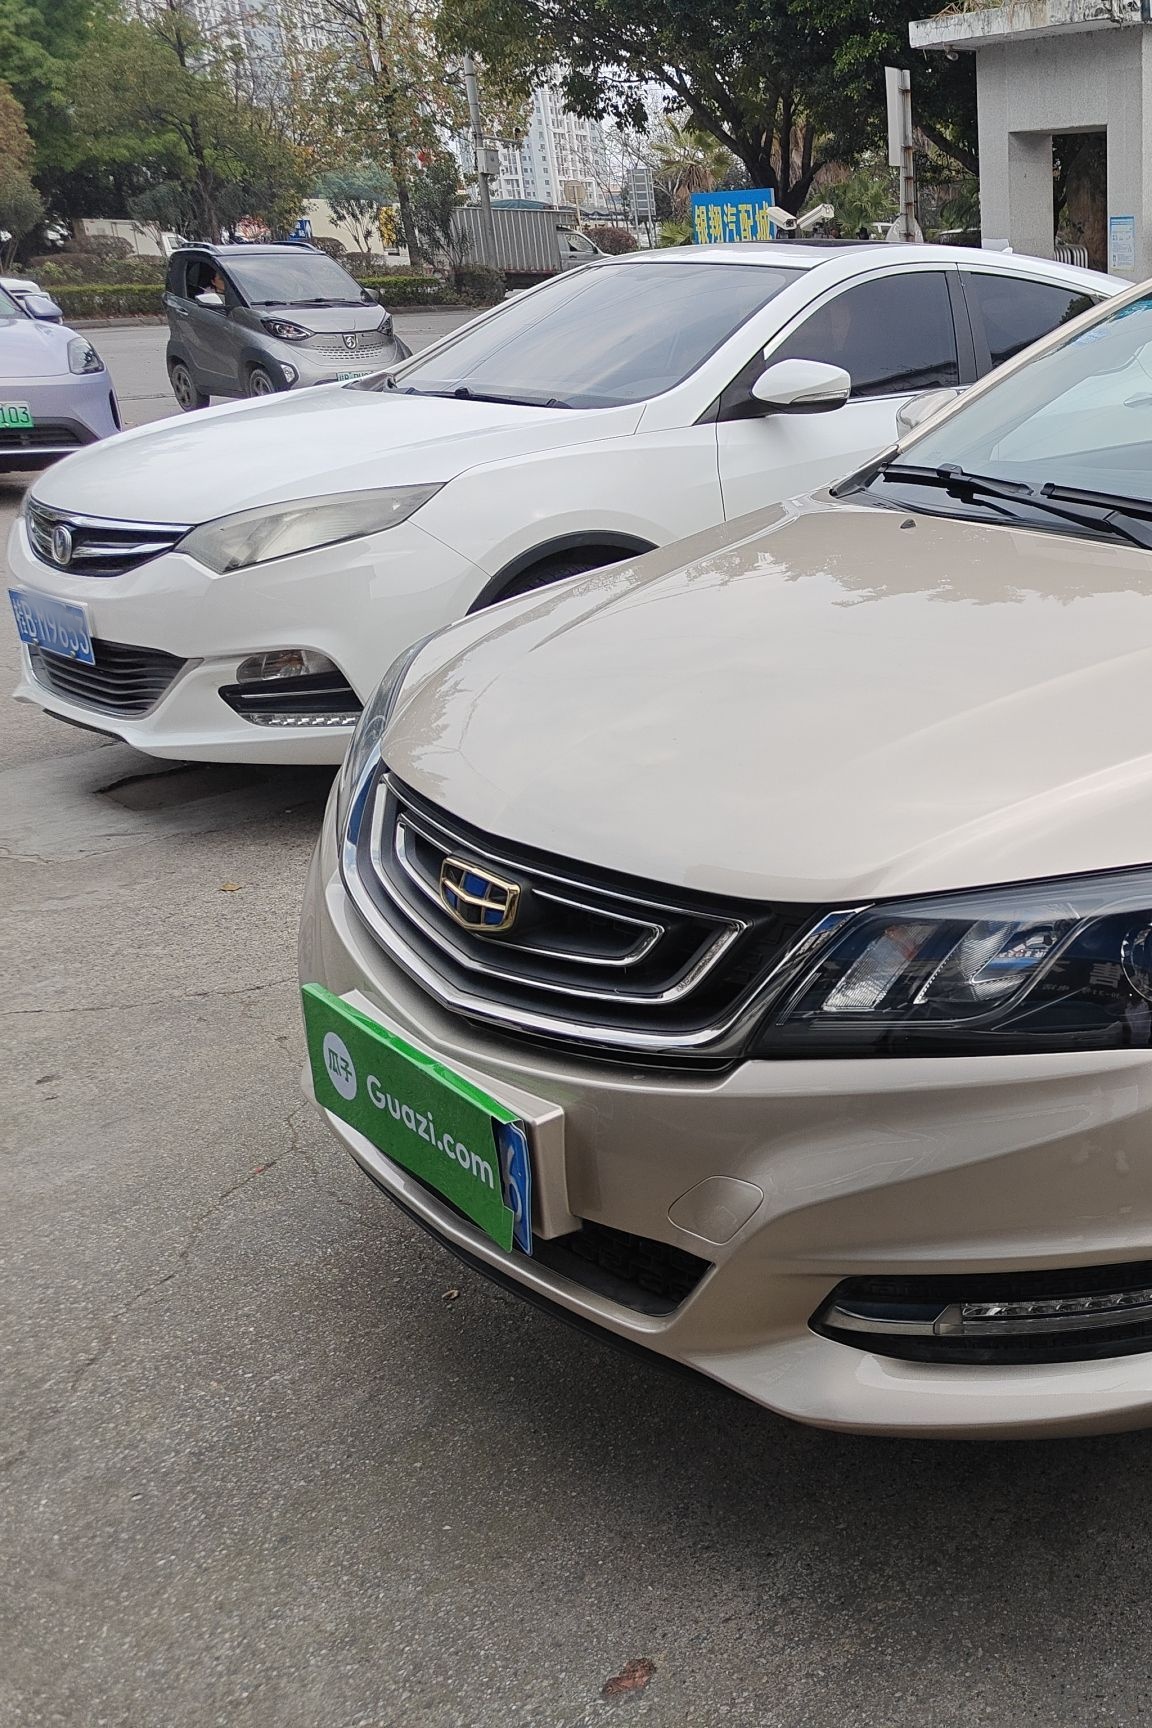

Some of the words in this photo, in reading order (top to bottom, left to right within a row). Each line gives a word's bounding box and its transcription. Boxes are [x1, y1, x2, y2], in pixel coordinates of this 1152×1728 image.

[695, 201, 772, 244] 银翔汽配城
[328, 1047, 353, 1083] 瓜子
[366, 1074, 495, 1189] Guazi.com
